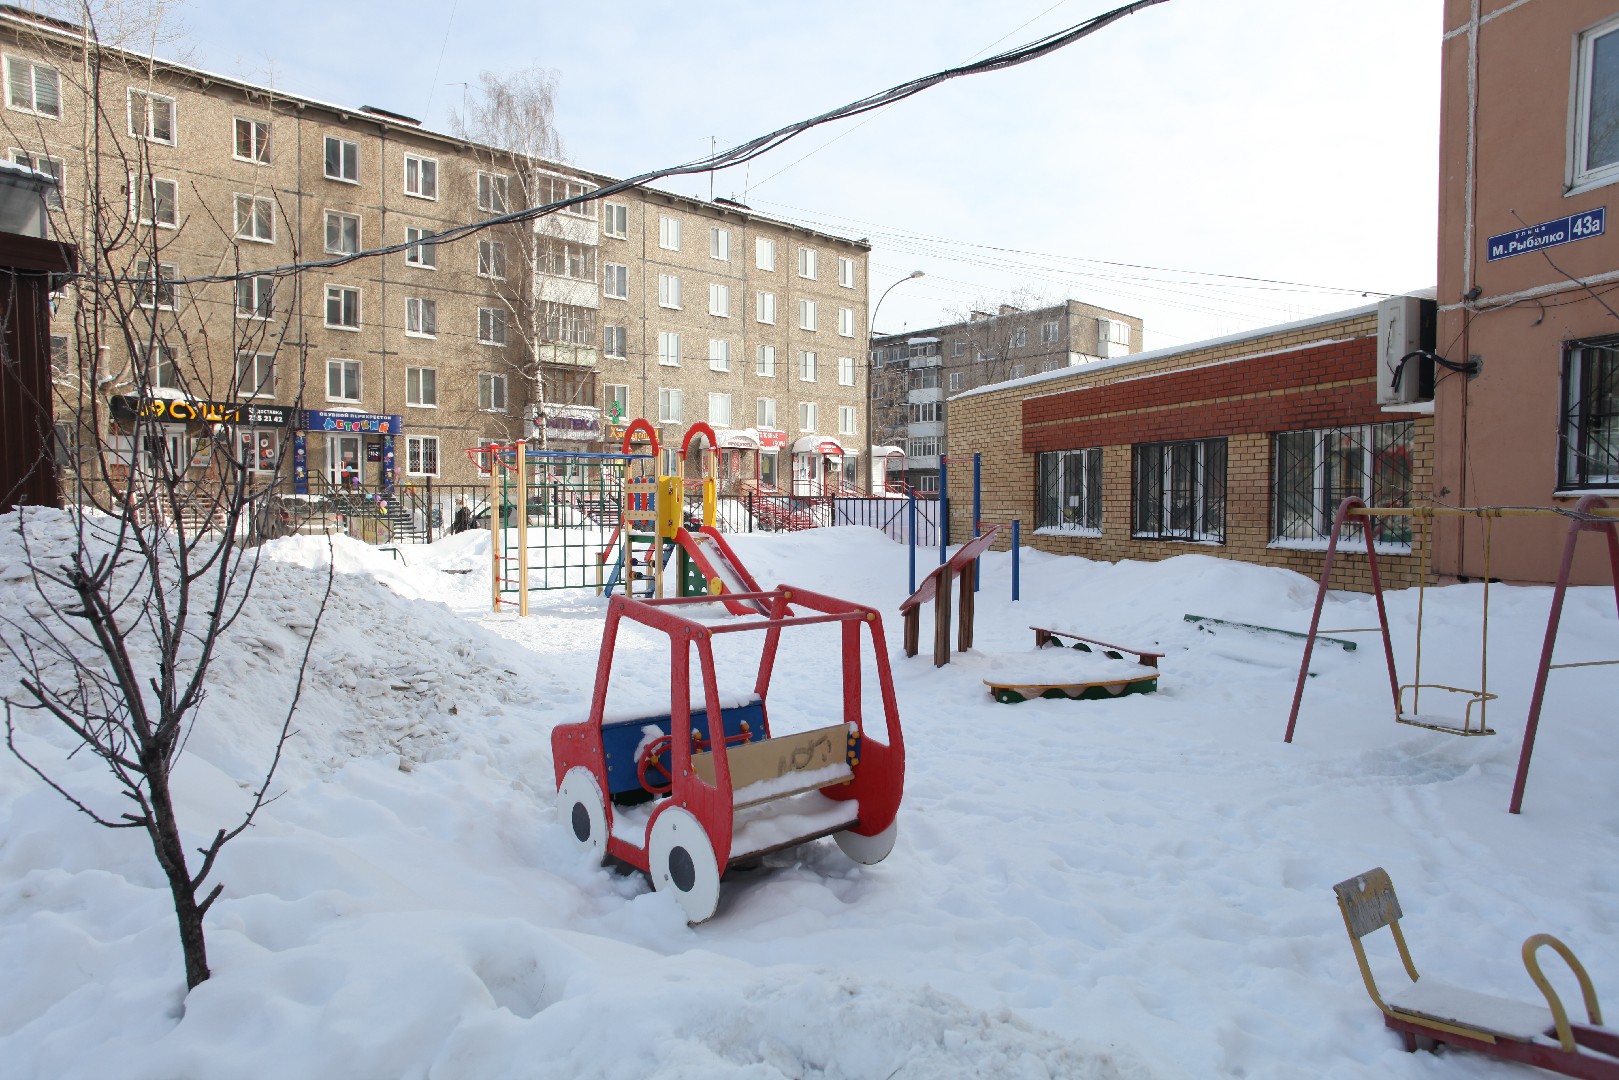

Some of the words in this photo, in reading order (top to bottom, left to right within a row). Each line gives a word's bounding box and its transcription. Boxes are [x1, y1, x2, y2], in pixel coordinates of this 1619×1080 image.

[1515, 225, 1546, 239] улица
[1572, 215, 1600, 236] 43а
[169, 399, 240, 422] СУШИ
[248, 414, 263, 422] 25
